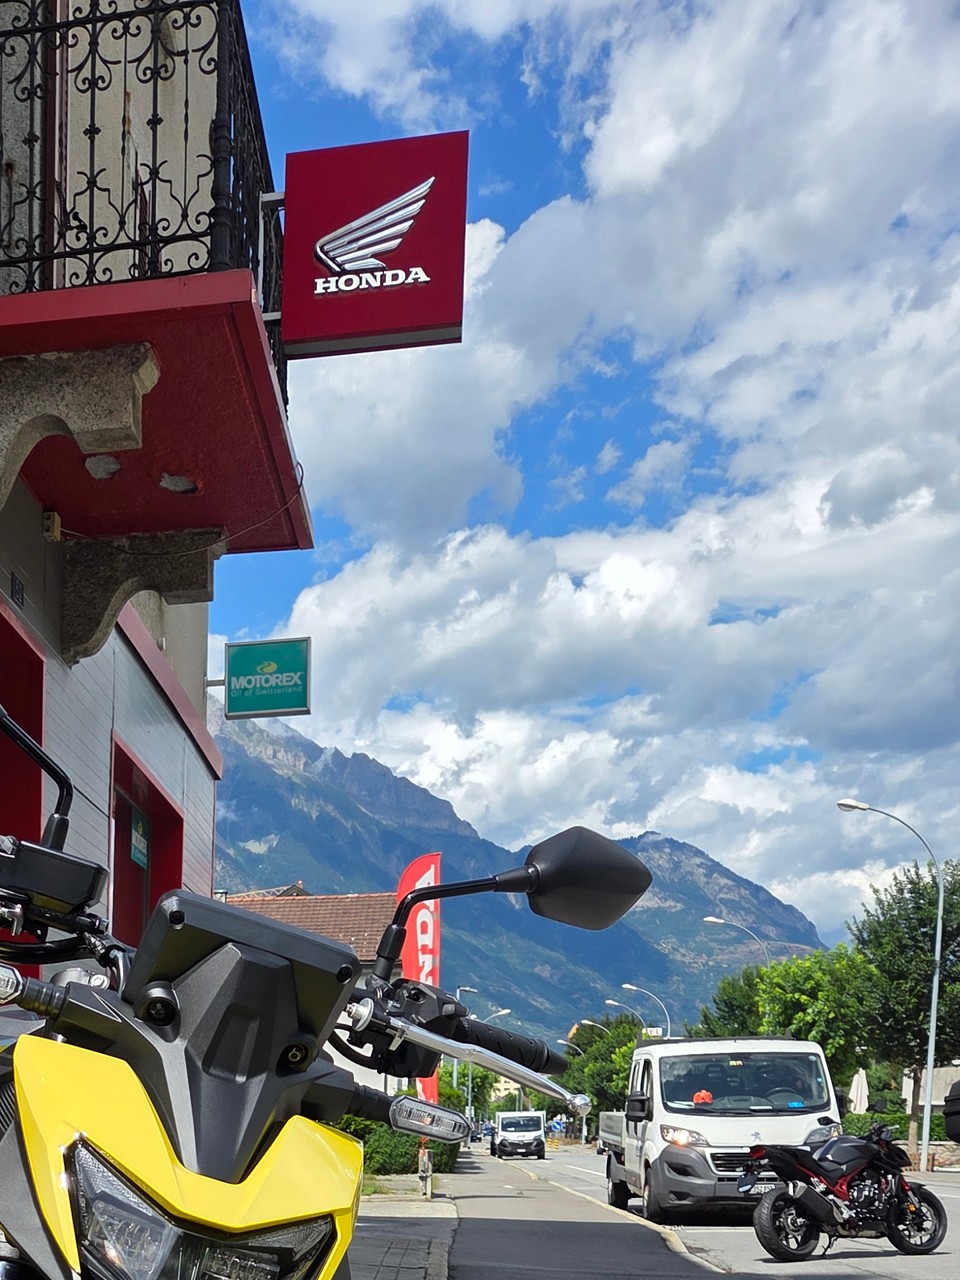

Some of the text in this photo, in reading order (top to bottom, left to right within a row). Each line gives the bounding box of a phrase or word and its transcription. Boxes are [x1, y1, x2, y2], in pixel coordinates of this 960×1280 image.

[314, 267, 430, 294] HONDA
[231, 672, 303, 689] MOTOREX
[256, 685, 303, 696] Switzerland
